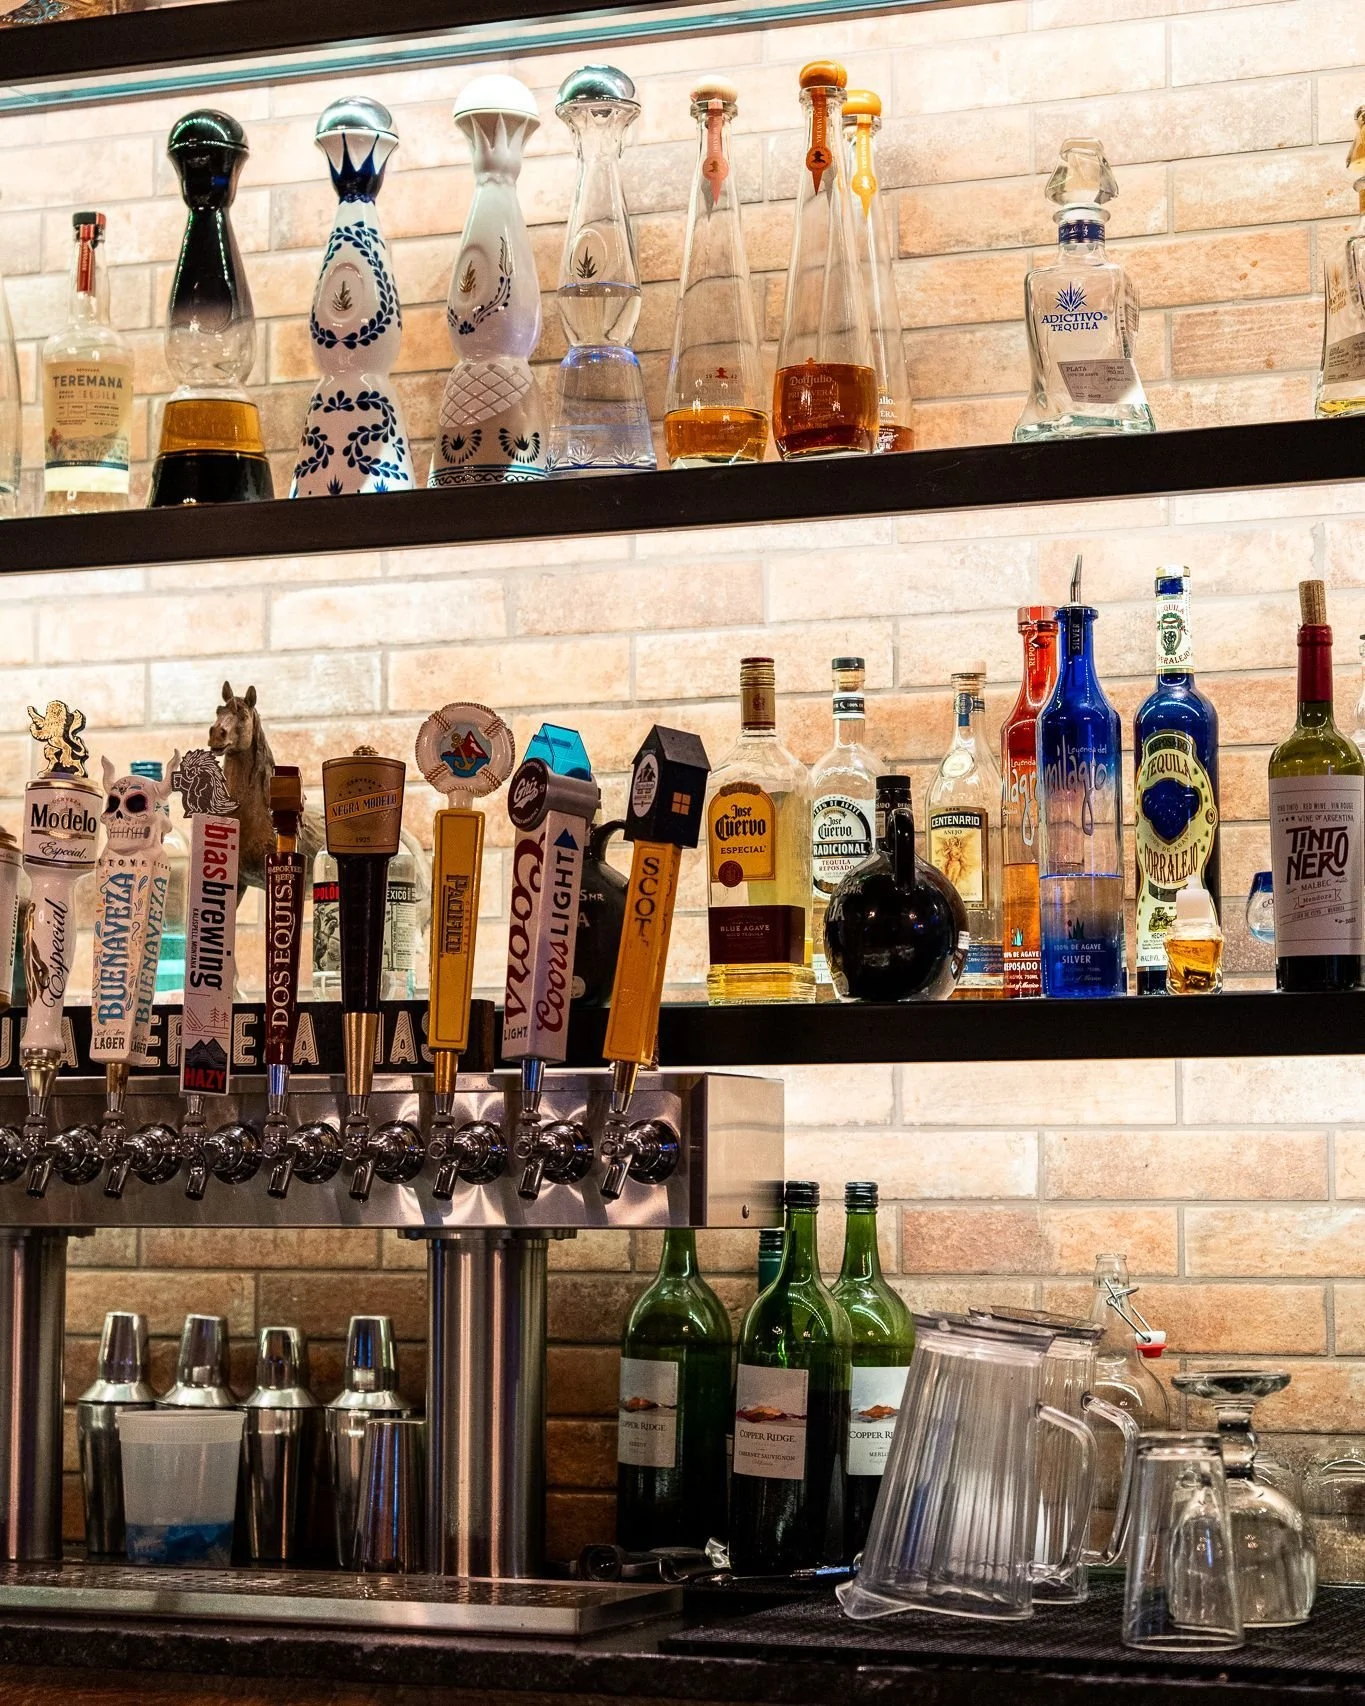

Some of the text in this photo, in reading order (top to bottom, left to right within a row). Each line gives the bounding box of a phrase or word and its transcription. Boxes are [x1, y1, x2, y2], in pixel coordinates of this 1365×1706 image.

[1041, 312, 1103, 324] ADICTIVO
[1051, 322, 1098, 332] TEQUILA
[53, 375, 123, 388] TEREMANA
[1071, 623, 1080, 650] SILVER
[1067, 744, 1107, 757] Leyenda del
[1145, 753, 1192, 781] TEQUILA
[514, 776, 541, 803] Griz
[331, 794, 397, 817] NEGRA MODELO
[732, 804, 752, 820] Jose
[841, 802, 860, 816] AGAVE
[31, 803, 97, 833] Modelo
[828, 817, 842, 827] Jose
[931, 815, 980, 827] CENTENARIO
[1298, 815, 1313, 823] WINE
[1323, 814, 1355, 823] ARGENTINA
[715, 814, 766, 841] Cuervo
[818, 824, 852, 840] Cuervo
[721, 846, 764, 854] ESPECIAL
[813, 843, 867, 856] RADICIONAL
[1286, 826, 1349, 868] TINTO
[268, 865, 302, 874] IMPORTED
[1144, 842, 1198, 885] CORRALEJO
[1286, 849, 1349, 885] NERO
[275, 873, 296, 881] BEER
[1301, 879, 1331, 890] MALBEC
[387, 890, 407, 900] EXICO
[1303, 893, 1332, 903] Mendoza
[445, 874, 470, 955] PACIFICO
[273, 884, 296, 965] EQUIS
[98, 872, 136, 1026] BUENAVEZA
[536, 851, 575, 1033] Coors LIGHT
[39, 897, 69, 1008] Especial
[135, 876, 168, 1027] BUENAVEZA
[190, 941, 198, 969] MONTANA
[1020, 950, 1039, 958] AGAVE
[1062, 955, 1091, 964] SILVER
[271, 971, 291, 1028] DOS
[503, 1026, 528, 1041] LIGHT
[94, 1036, 125, 1050] LAGER
[131, 1041, 147, 1054] LAGER
[184, 1066, 225, 1091] HAZY
[641, 1422, 666, 1432] RIDGE
[739, 1430, 794, 1443] COPPER RIDGE
[849, 1430, 882, 1439] COPPER
[761, 1453, 795, 1461] SAUVIGNON
